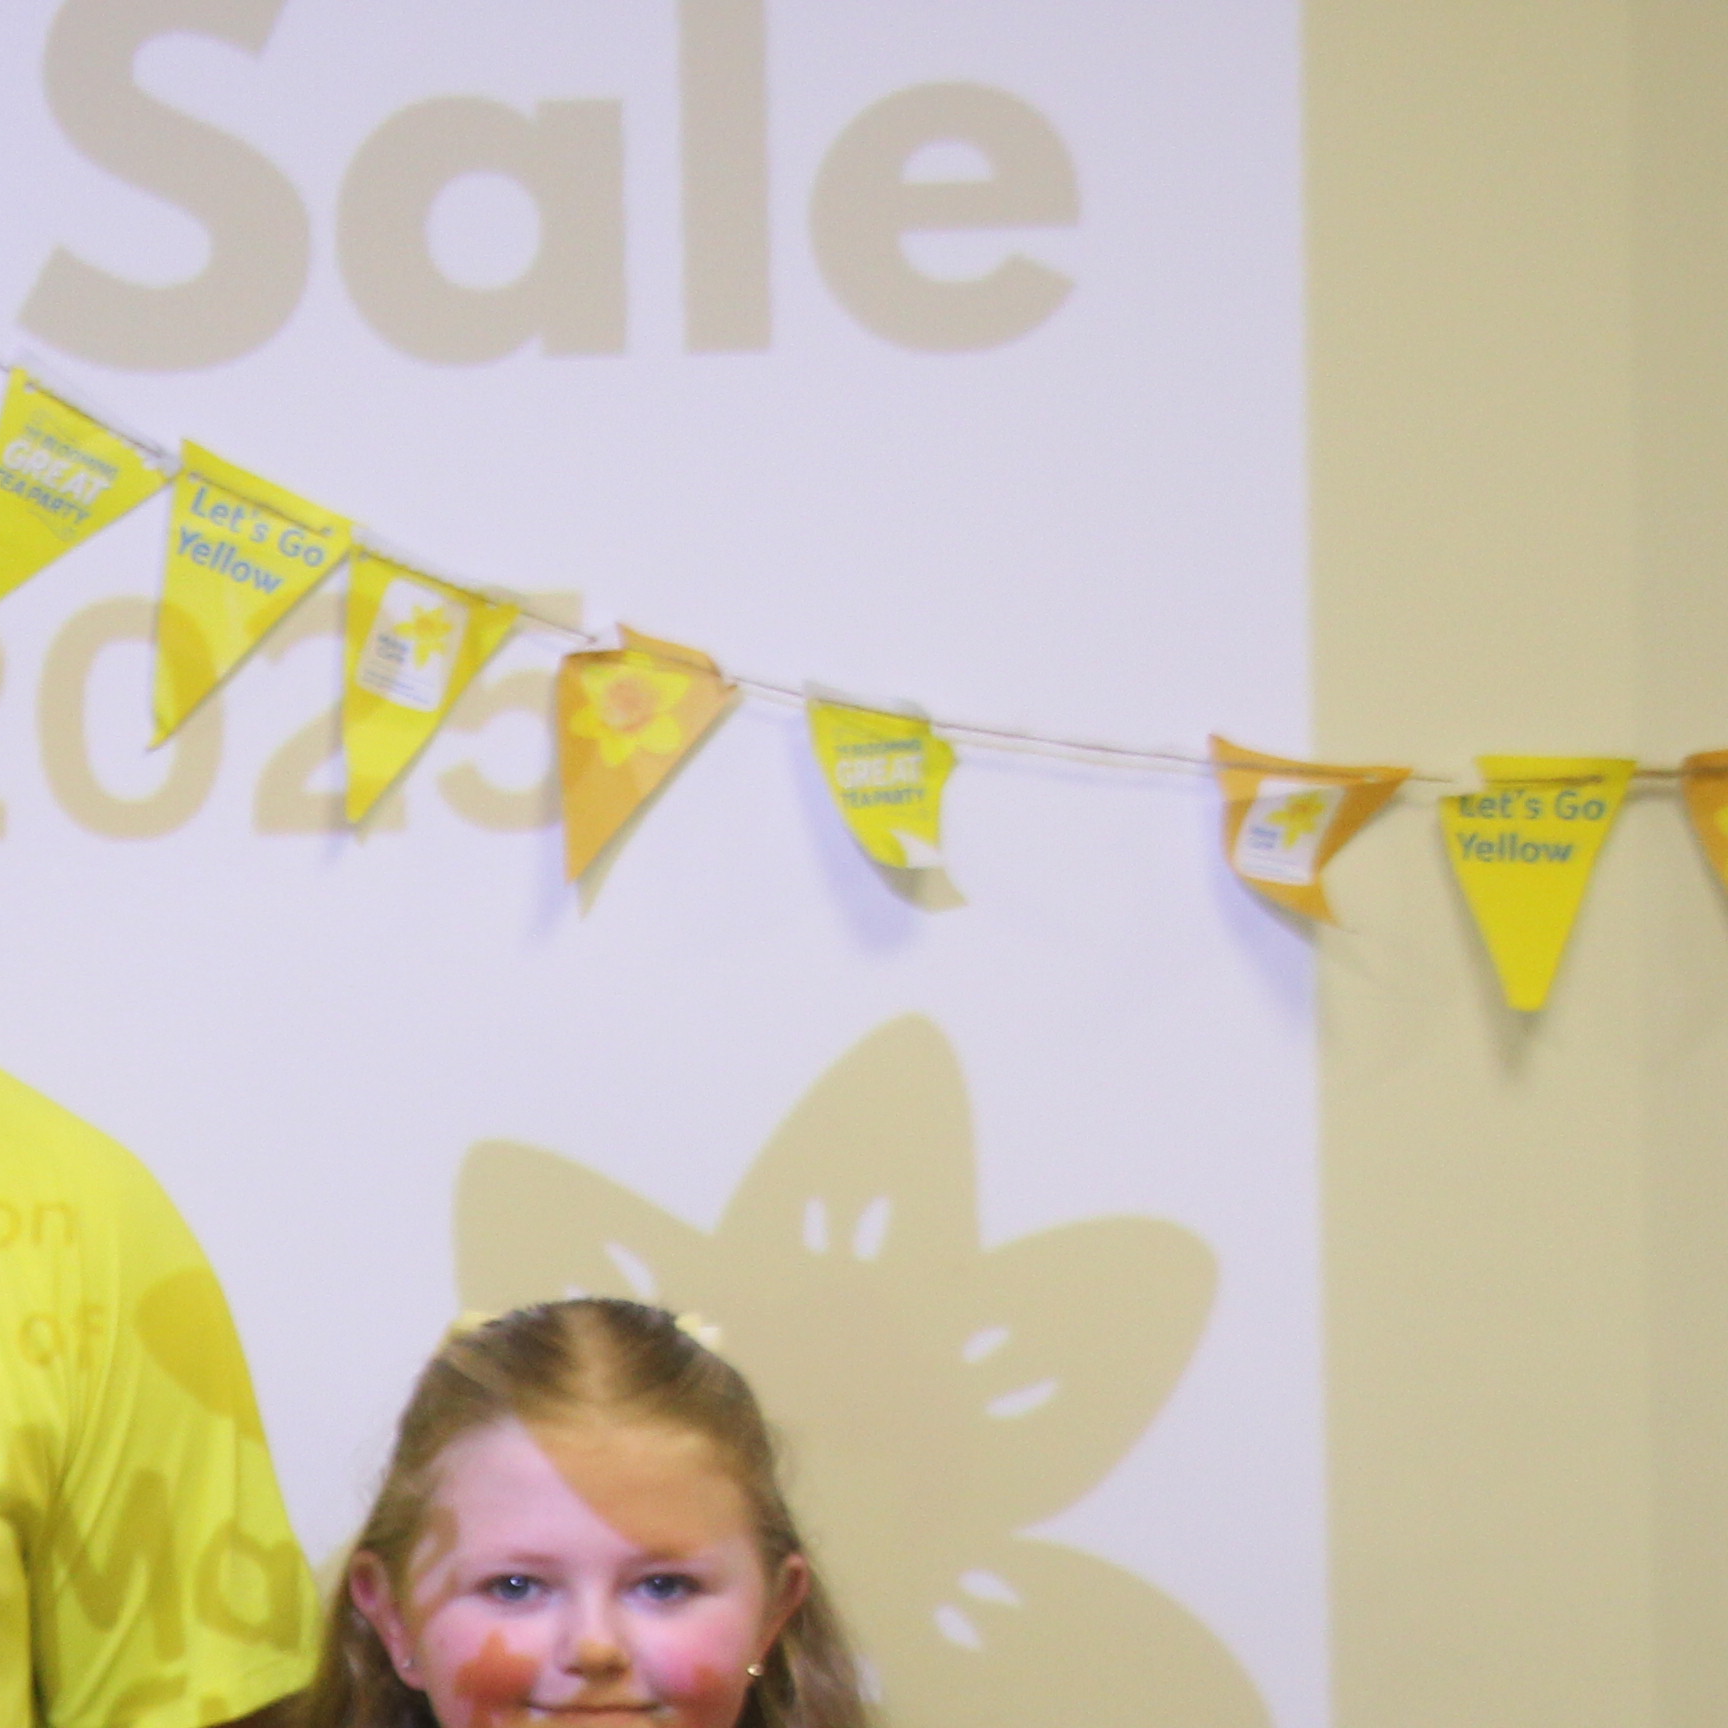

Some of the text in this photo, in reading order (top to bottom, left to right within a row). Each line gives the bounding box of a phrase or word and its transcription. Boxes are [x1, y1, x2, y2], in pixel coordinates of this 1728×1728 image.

[17, 0, 1082, 374] Sale
[1, 437, 112, 505] GREAT
[27, 485, 92, 526] PARTY
[189, 484, 325, 568] Let's Go
[177, 526, 285, 595] Yellow
[1459, 789, 1606, 821] Let's Go
[1456, 832, 1574, 863] Yellow
[19, 1302, 108, 1373] of
